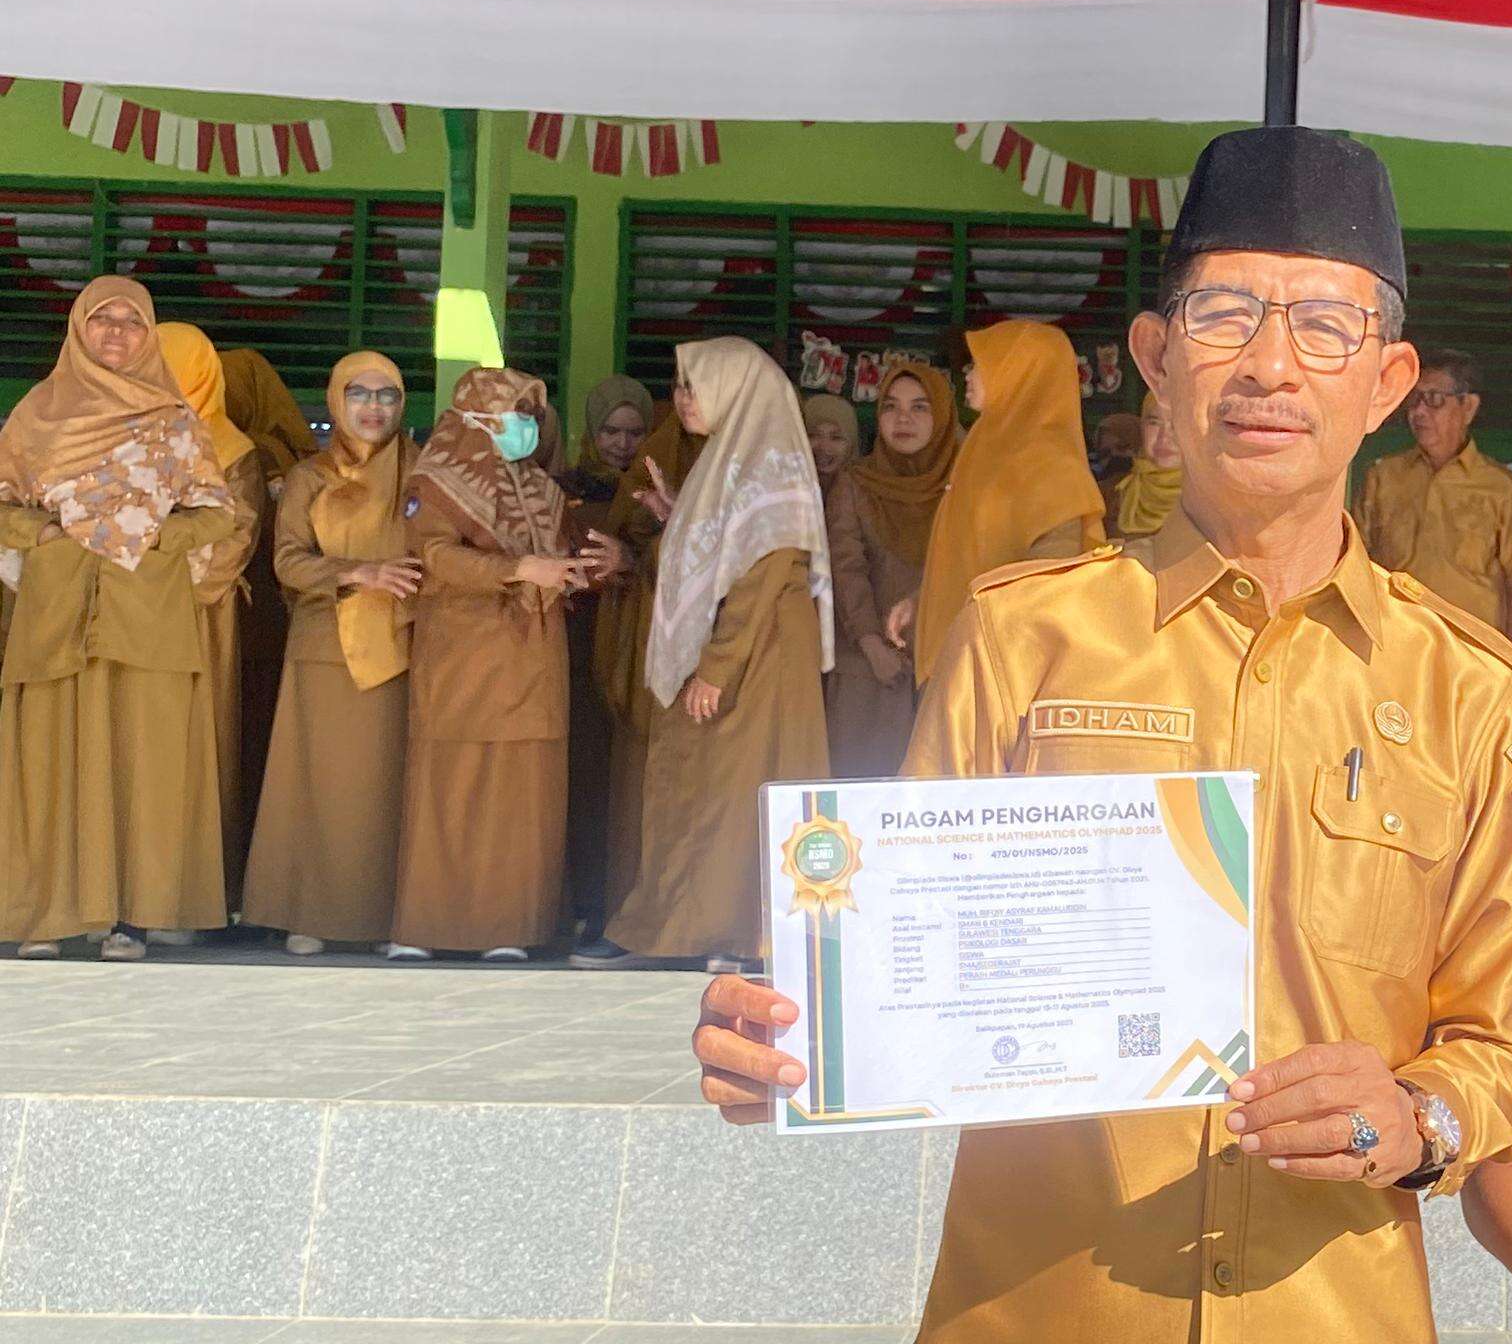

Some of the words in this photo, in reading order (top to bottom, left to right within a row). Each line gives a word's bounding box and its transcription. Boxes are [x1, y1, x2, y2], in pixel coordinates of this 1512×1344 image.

[1047, 707, 1177, 734] IDHAM
[881, 809, 975, 829] PIAGAM
[981, 802, 1156, 826] PENGHARGAAN
[877, 835, 936, 847] NATIONAL
[936, 833, 985, 845] SCIENCE
[997, 828, 1076, 842] MATHEMATICS
[1078, 825, 1133, 838] OLYMPIAD
[1135, 825, 1163, 836] 2025
